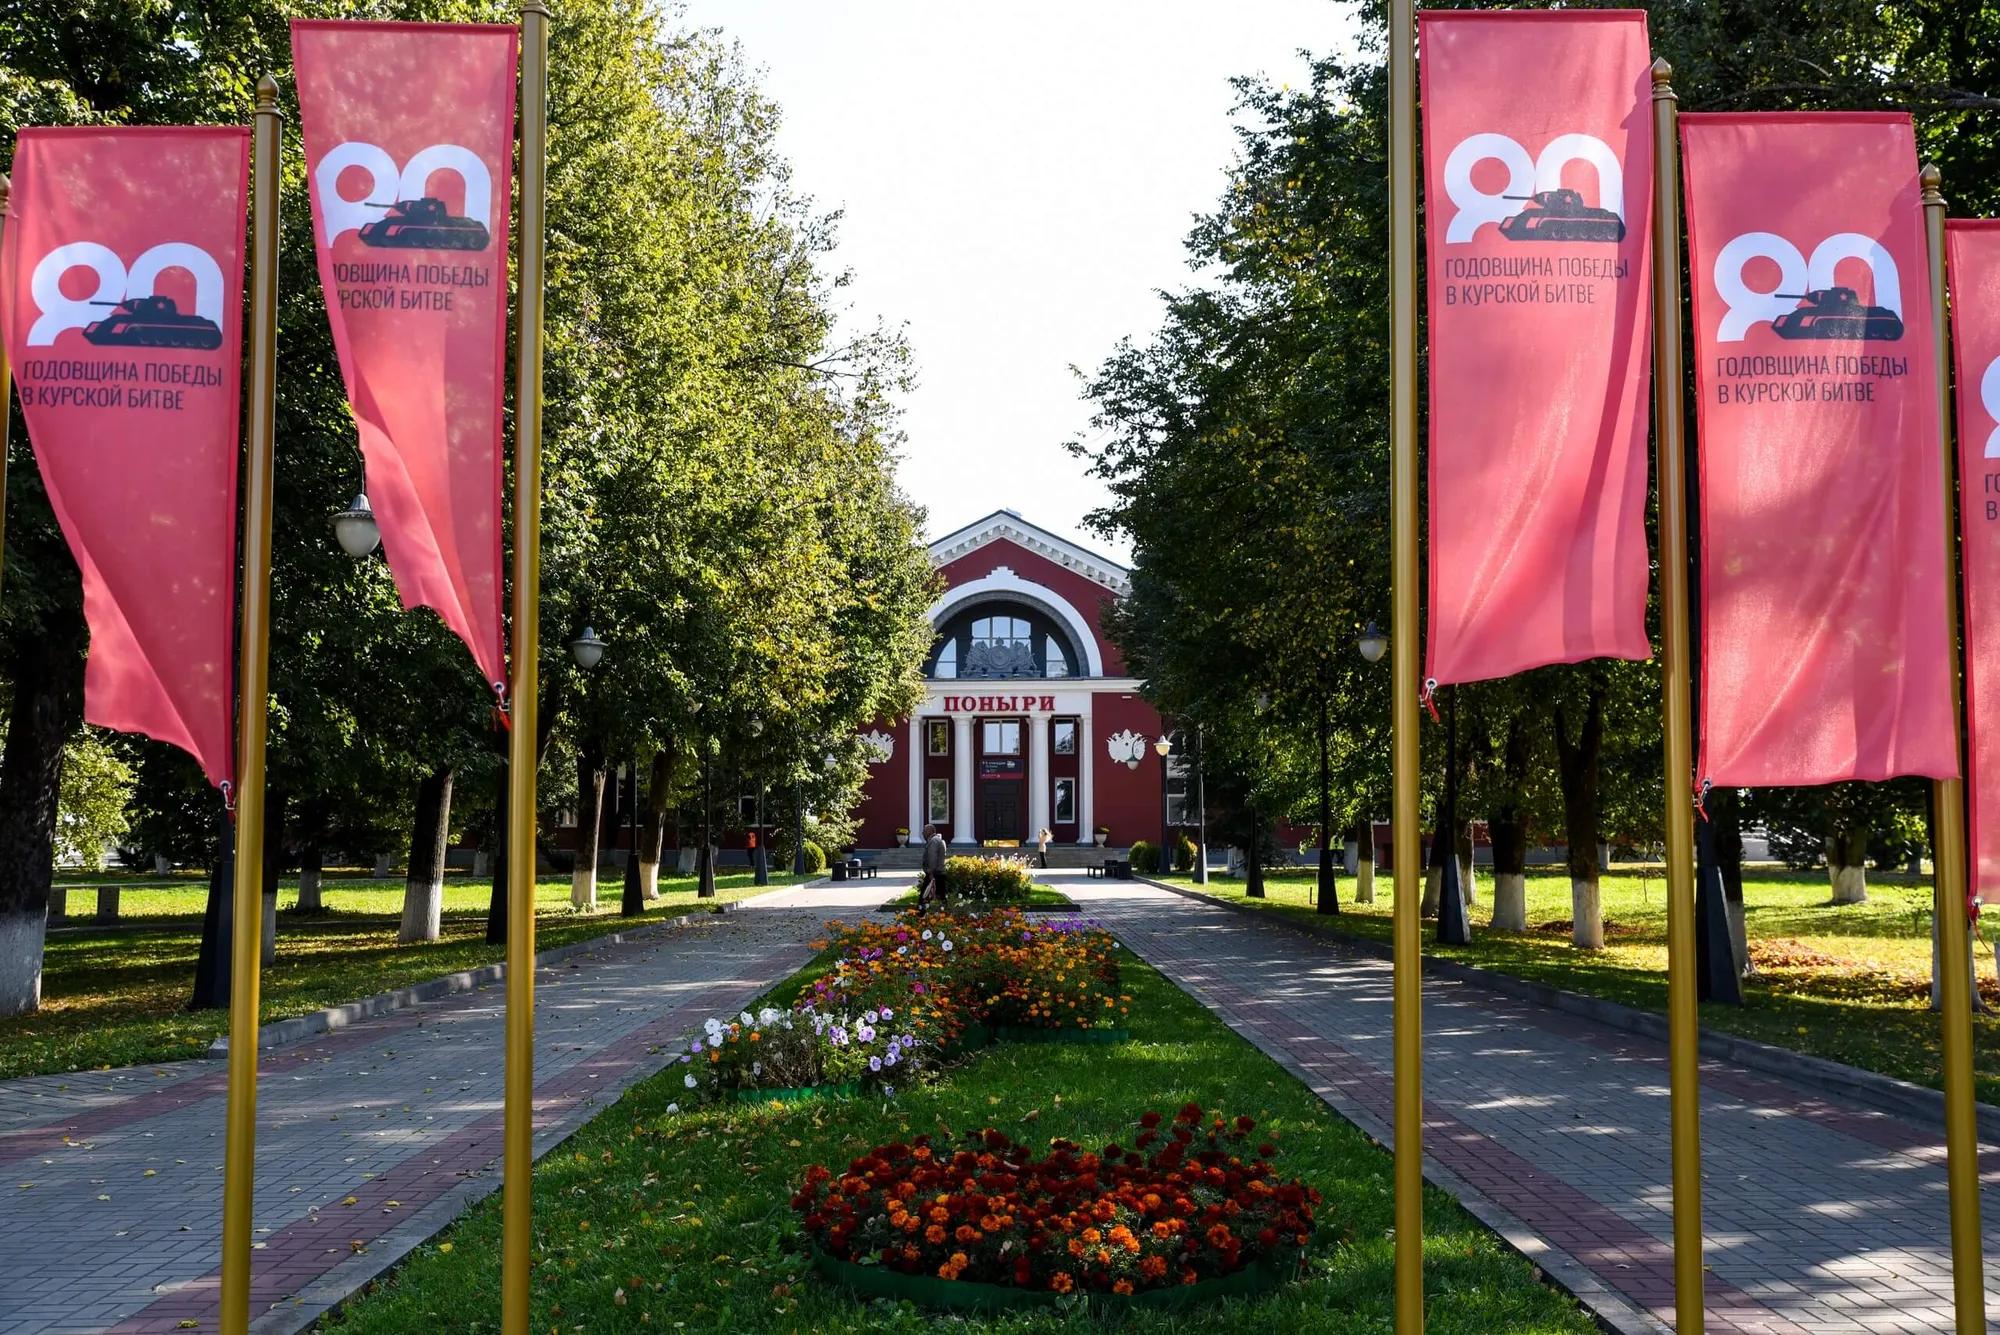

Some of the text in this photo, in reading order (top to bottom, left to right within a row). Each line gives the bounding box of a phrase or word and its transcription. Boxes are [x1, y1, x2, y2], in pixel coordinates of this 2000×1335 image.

[333, 263, 489, 288] ОВЩИНА ПОБЕДЫ
[1446, 257, 1628, 280] ГОДОВЩИНА ПОБЕДЫ
[337, 286, 453, 311] РСКОЙ БИТВЕ
[1446, 280, 1595, 305] В КУРСКОЙ БИТВЕ
[23, 359, 222, 387] ГОДОВЩИНА ПОБЕДЫ
[1717, 355, 1908, 379] ГОДОВЩИНА ПОБЕДЫ
[22, 384, 184, 410] В КУРСКОЙ БИТВЕ
[1718, 379, 1875, 405] В КУРСКОЙ БИТВЕ
[1986, 501, 1998, 521] В
[943, 695, 1056, 712] ПОНЫРИ
